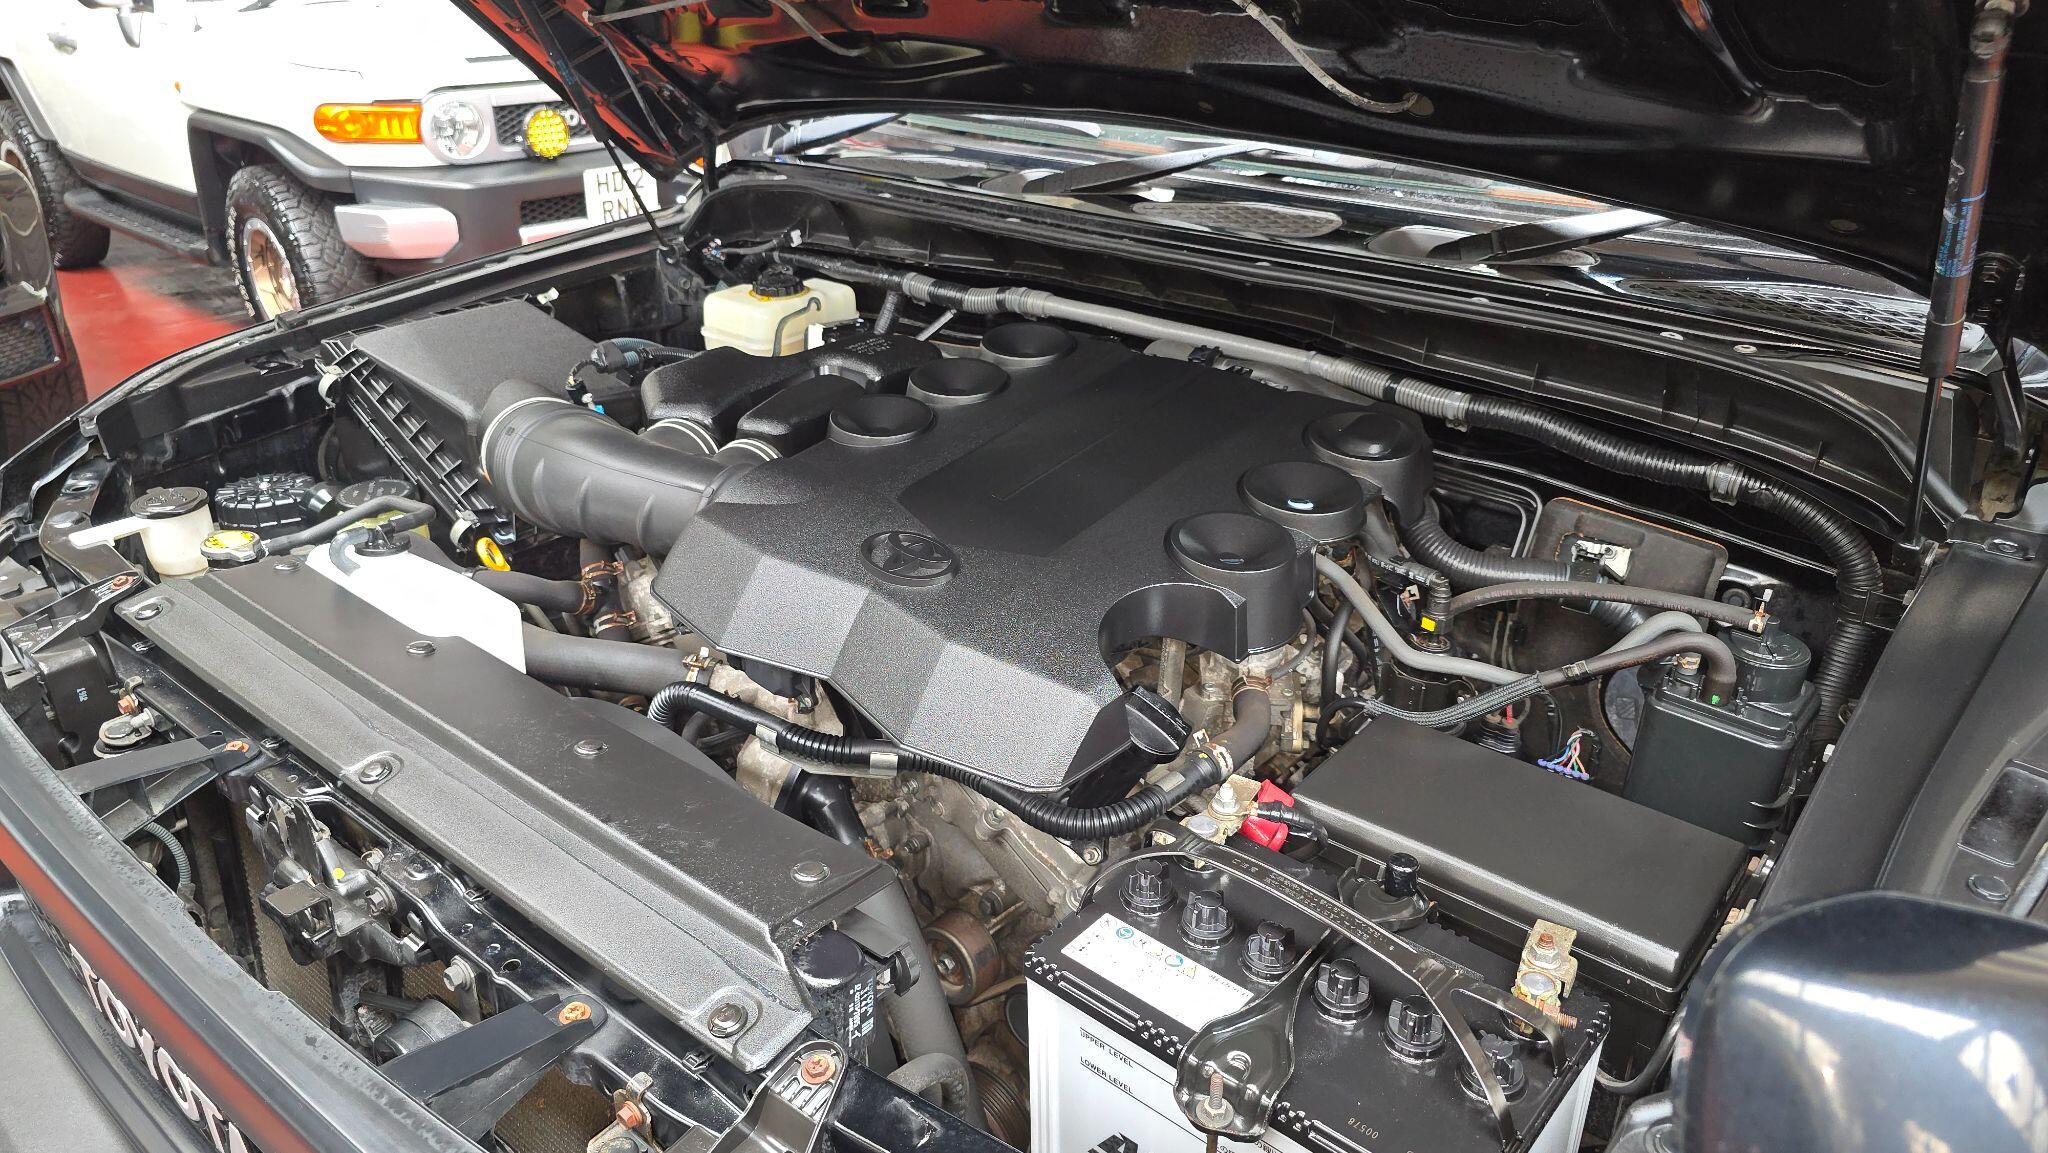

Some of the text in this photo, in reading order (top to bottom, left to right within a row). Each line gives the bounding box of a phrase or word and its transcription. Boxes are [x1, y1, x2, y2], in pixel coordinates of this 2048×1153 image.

[1079, 1029, 1134, 1069] UPPER LEVEL
[1080, 1055, 1134, 1095] LOWER LEVEL
